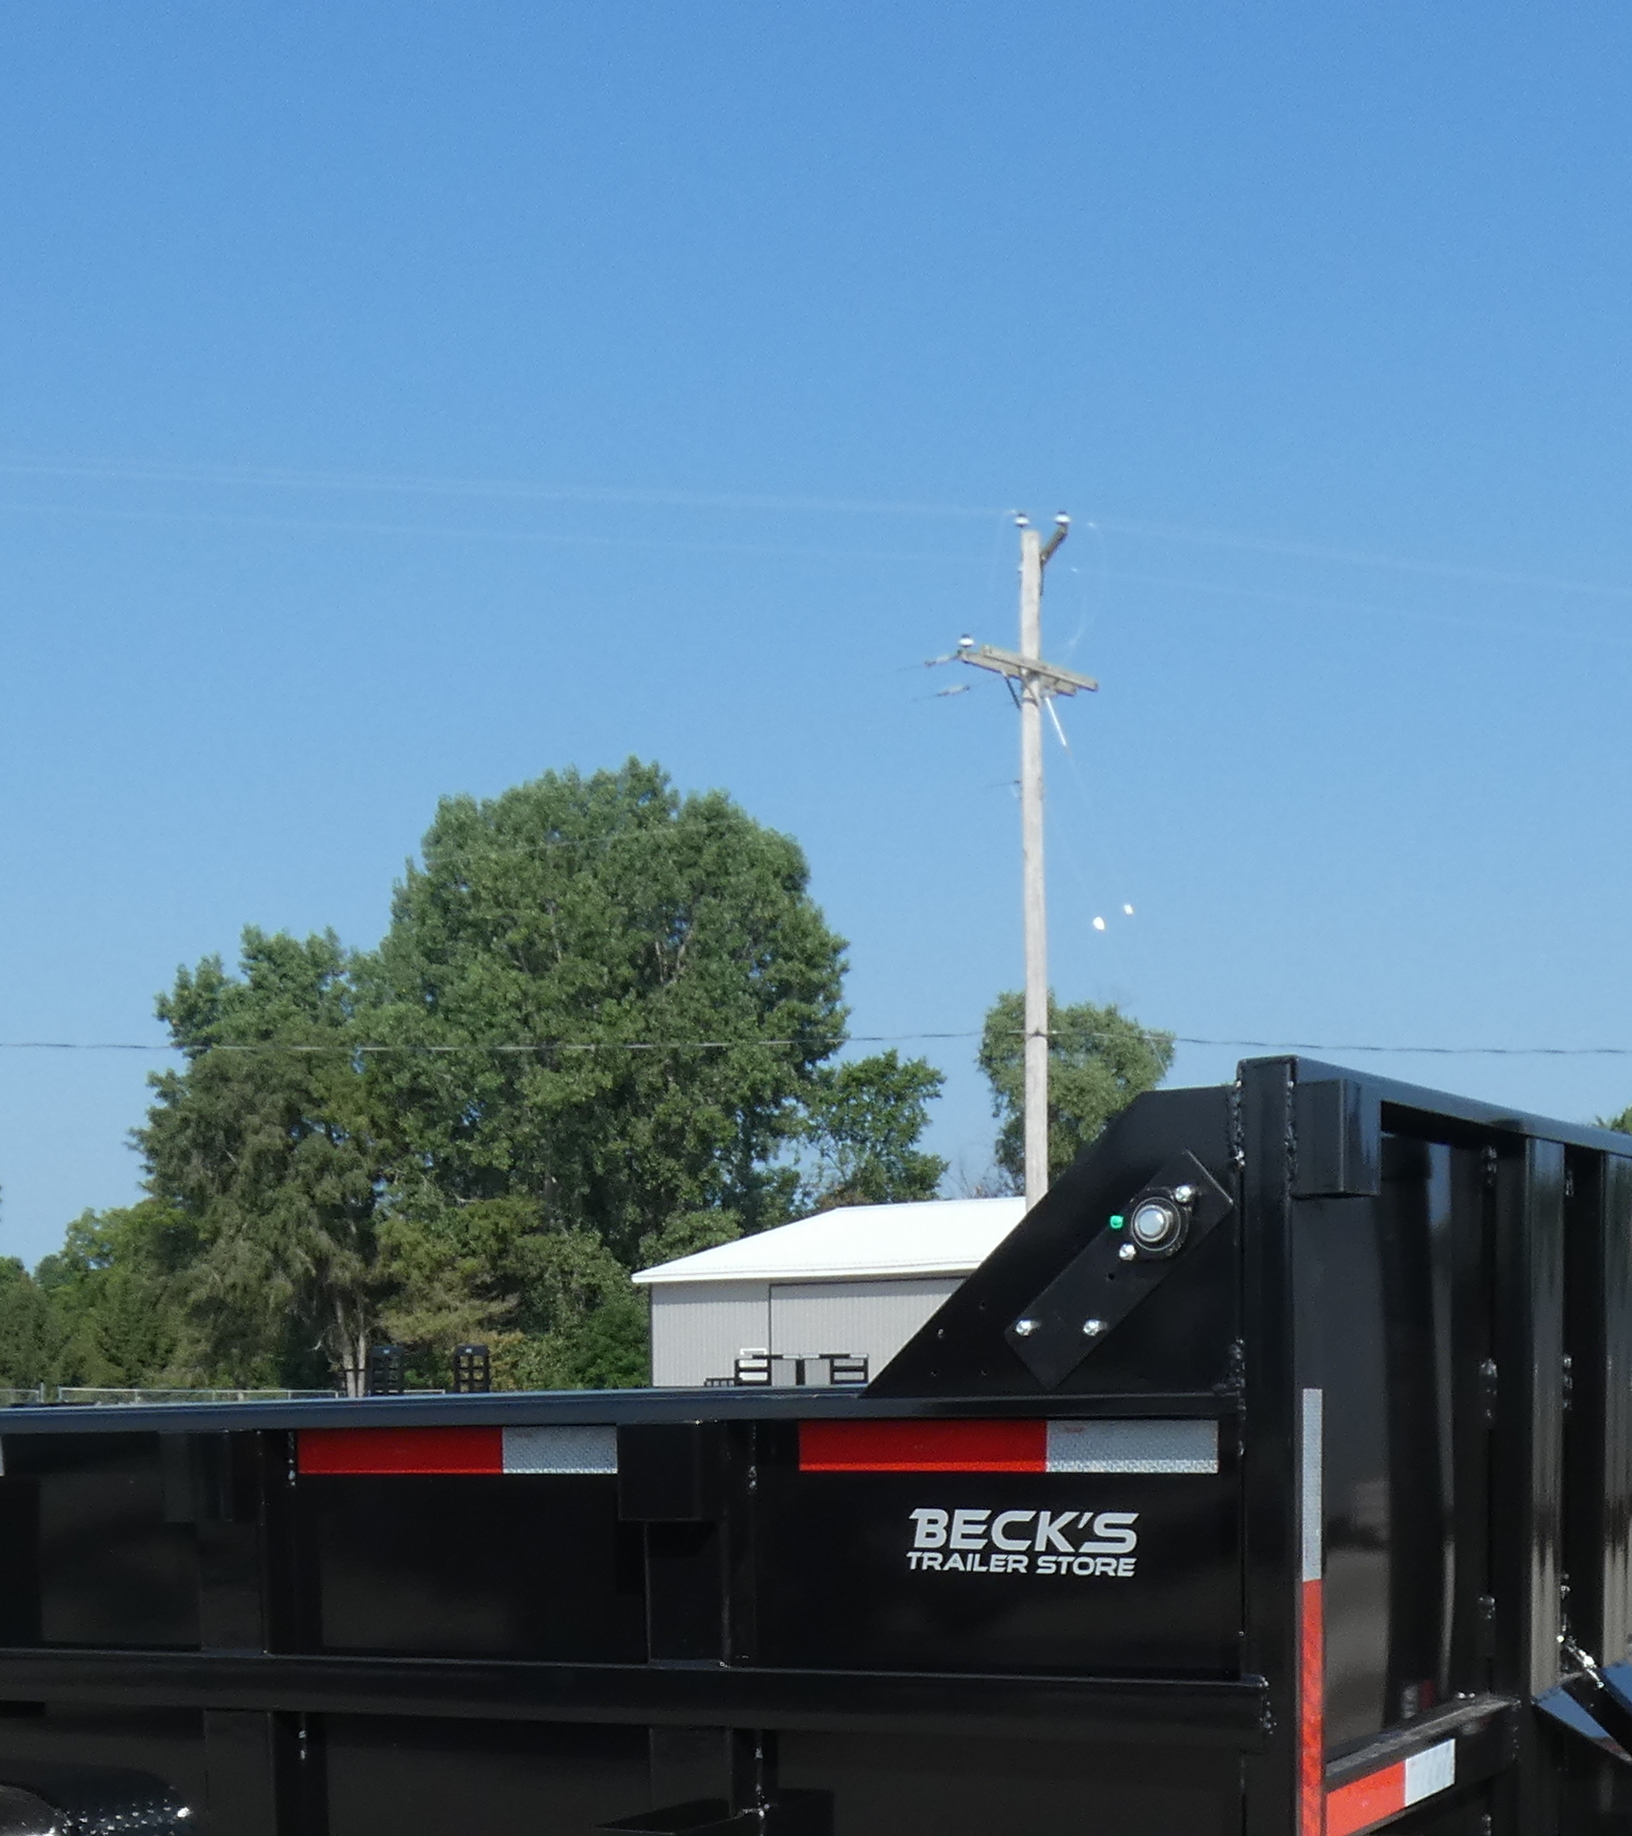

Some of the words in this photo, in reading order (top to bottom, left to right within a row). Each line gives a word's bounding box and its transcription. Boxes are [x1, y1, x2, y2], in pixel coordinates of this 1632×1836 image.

[908, 1507, 1141, 1555] BECK'S
[906, 1550, 1029, 1574] TRAILER
[1035, 1555, 1138, 1577] STORE
